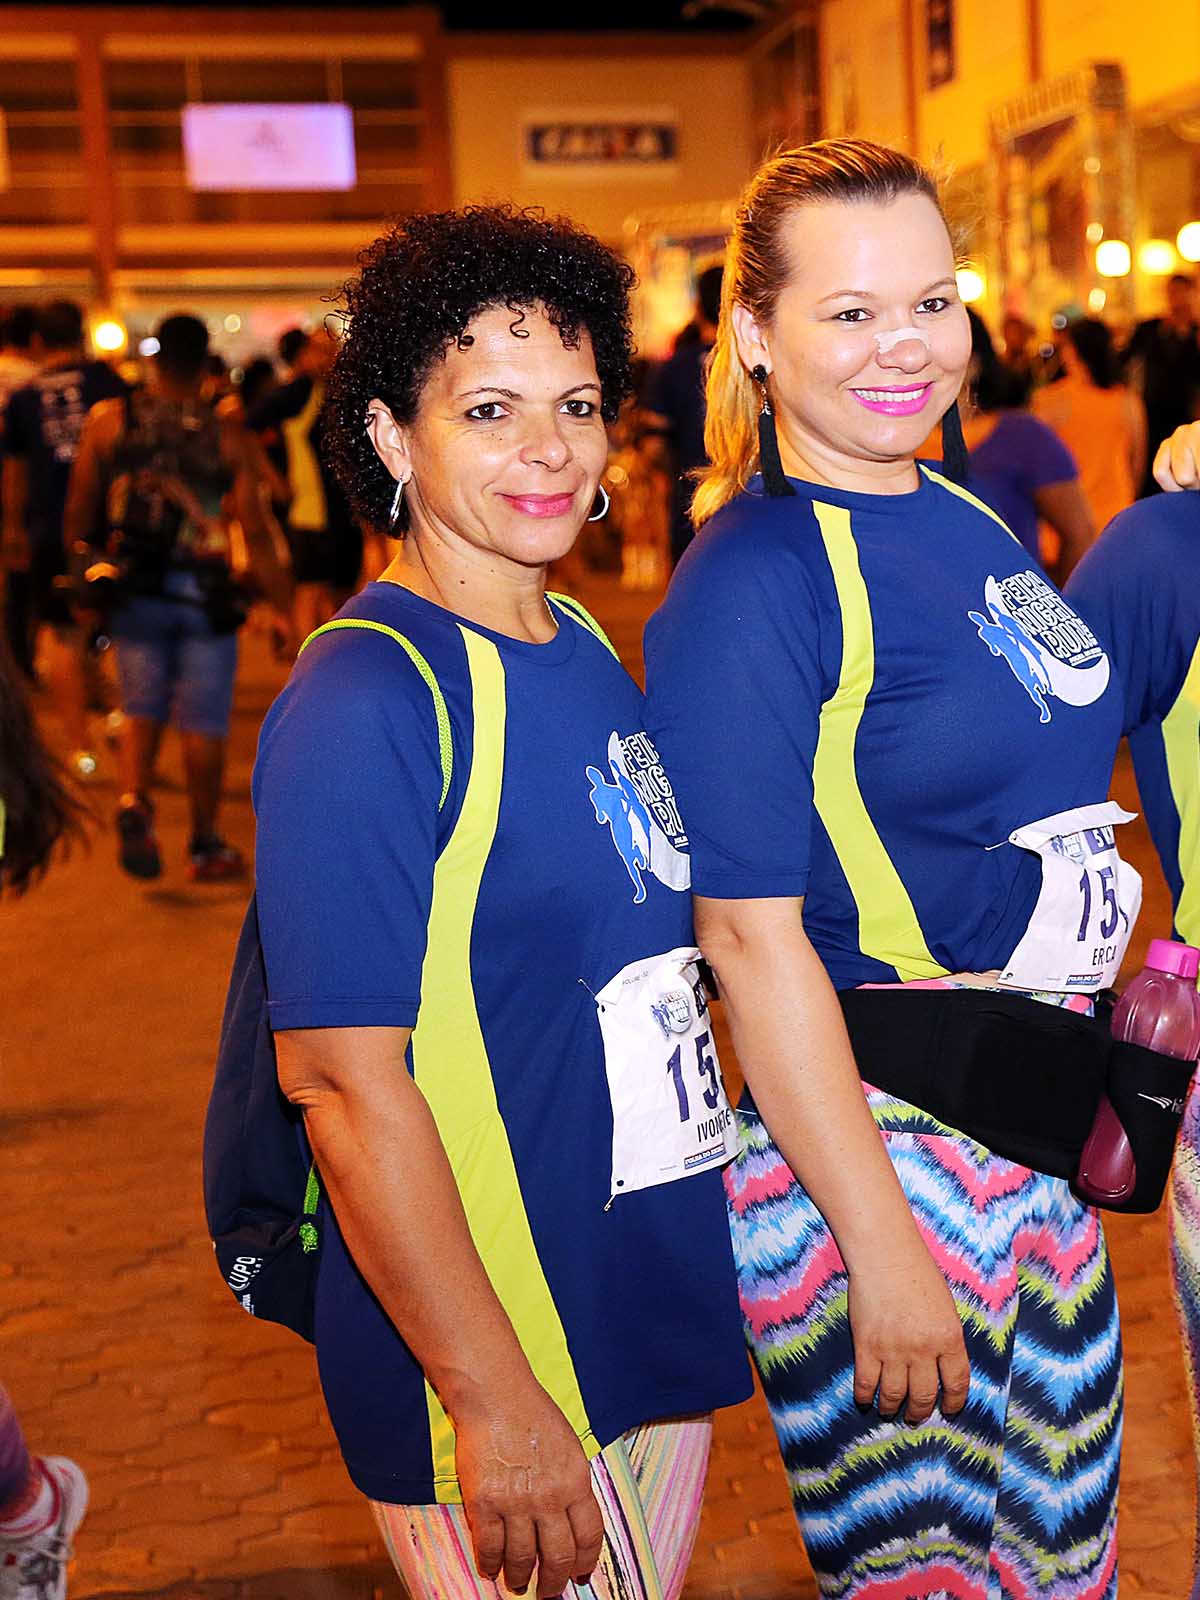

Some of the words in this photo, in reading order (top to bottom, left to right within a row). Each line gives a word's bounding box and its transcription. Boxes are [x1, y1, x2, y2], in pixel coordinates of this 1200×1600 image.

[997, 569, 1053, 611] FEIRA
[1011, 592, 1078, 636] NIGHT
[1040, 618, 1090, 659] RUN
